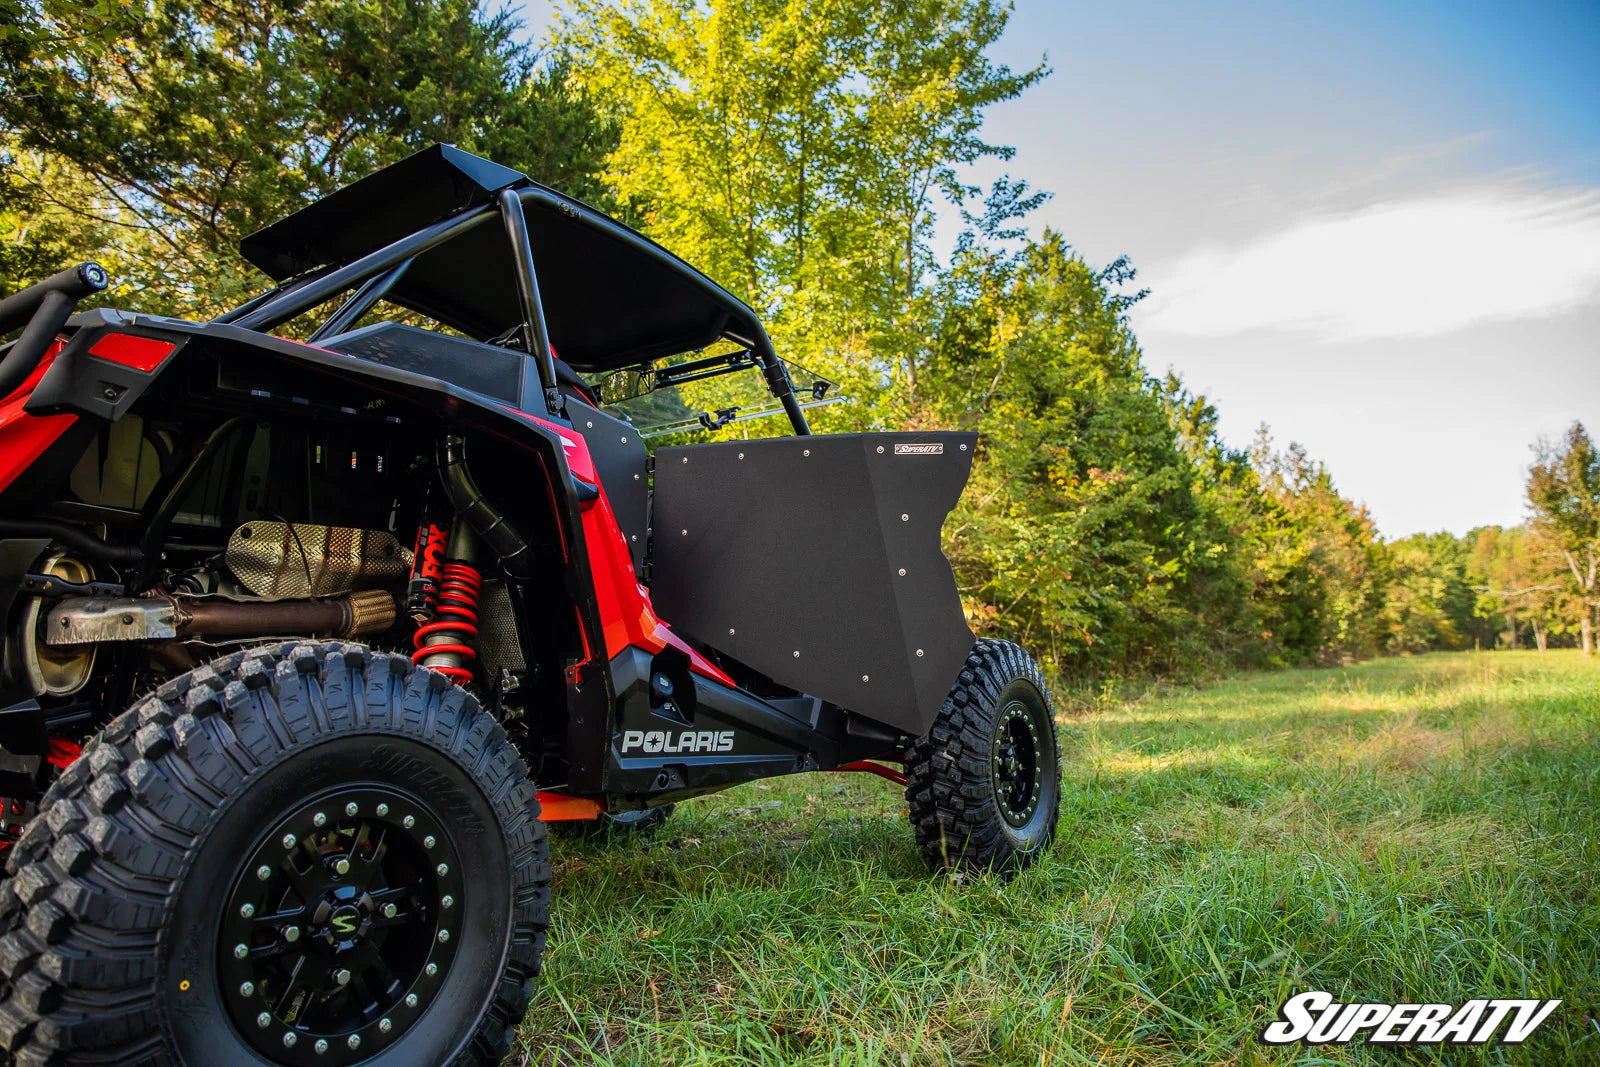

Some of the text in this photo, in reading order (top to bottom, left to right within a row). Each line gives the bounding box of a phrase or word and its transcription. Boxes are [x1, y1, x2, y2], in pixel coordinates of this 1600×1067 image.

[898, 445, 939, 453] SUPERATV
[421, 524, 449, 580] FOX
[621, 730, 735, 753] POLARIS
